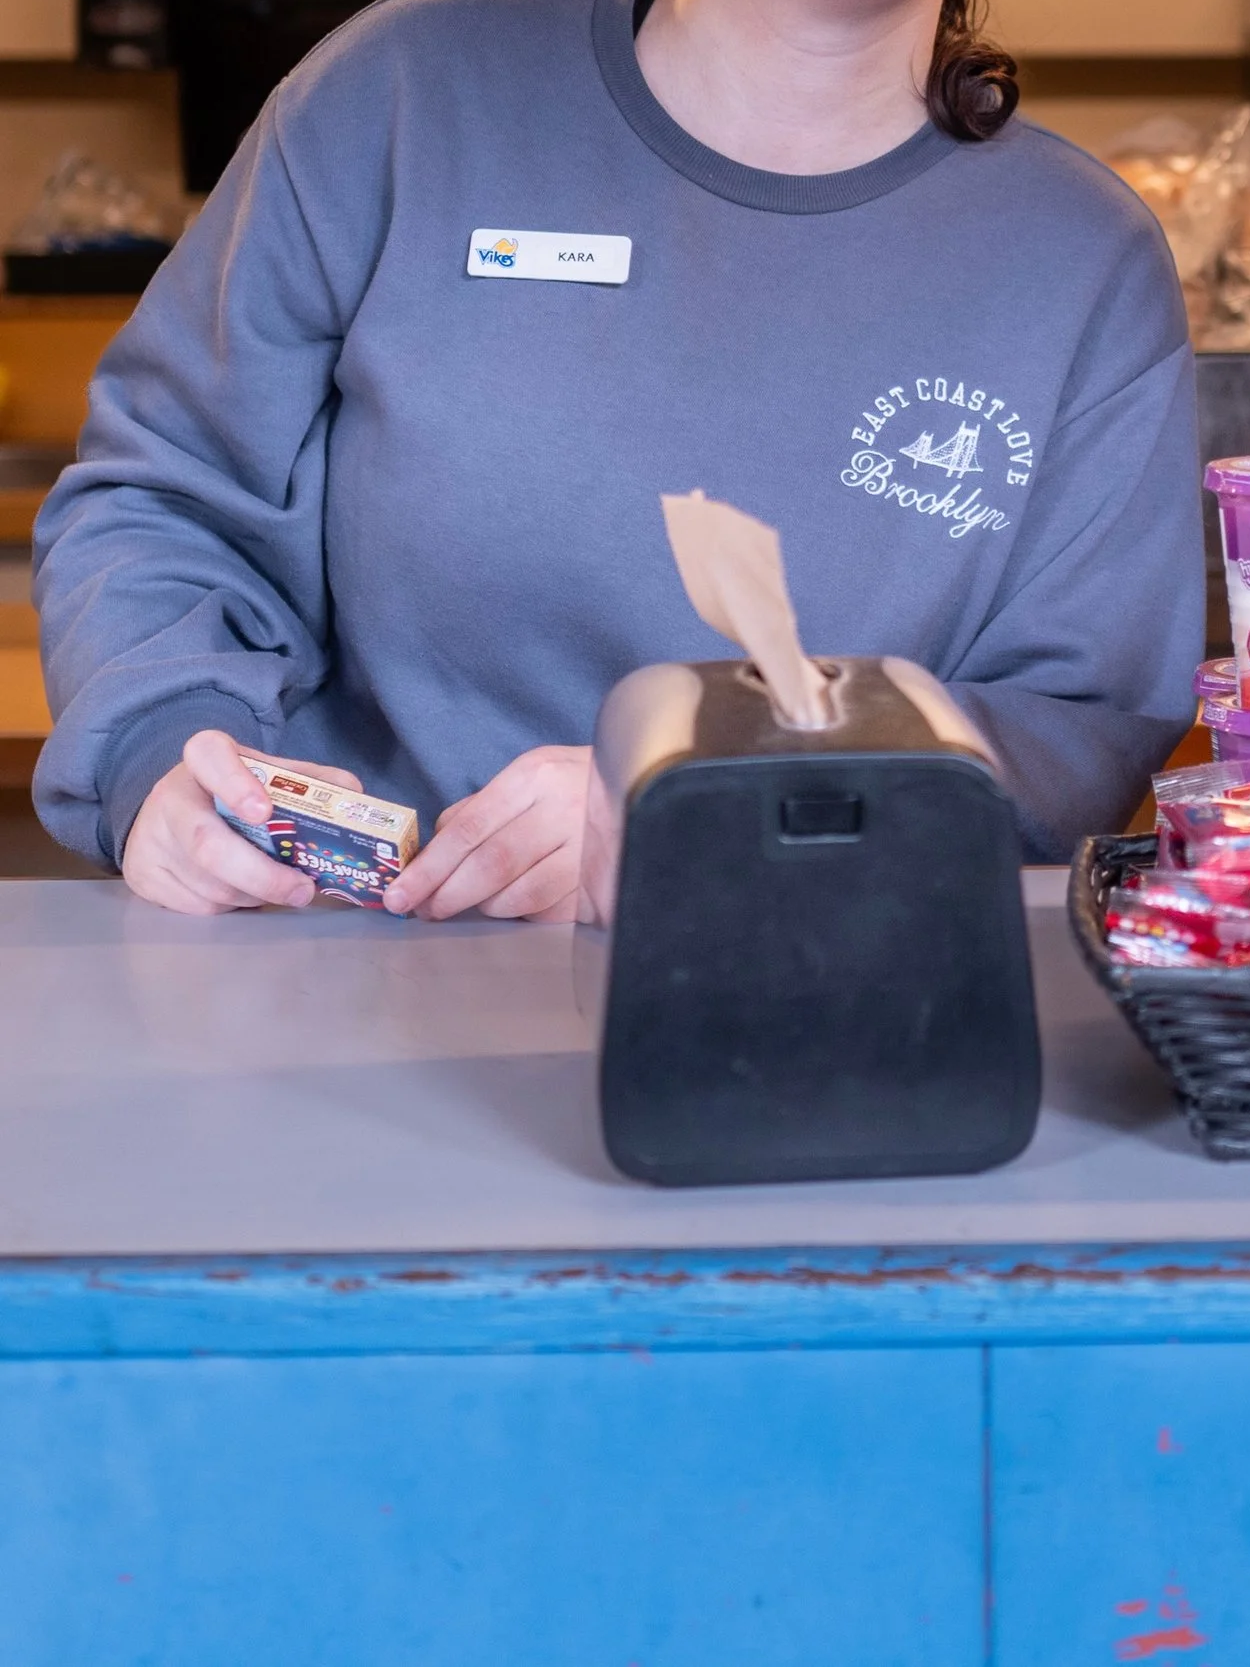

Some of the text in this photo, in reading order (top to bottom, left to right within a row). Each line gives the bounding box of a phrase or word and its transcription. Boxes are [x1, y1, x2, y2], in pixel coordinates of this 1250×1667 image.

[476, 248, 515, 267] Vikes
[558, 252, 595, 262] KARA
[851, 377, 1034, 486] EAST COAST LOVE
[840, 449, 1011, 539] Brooklyn
